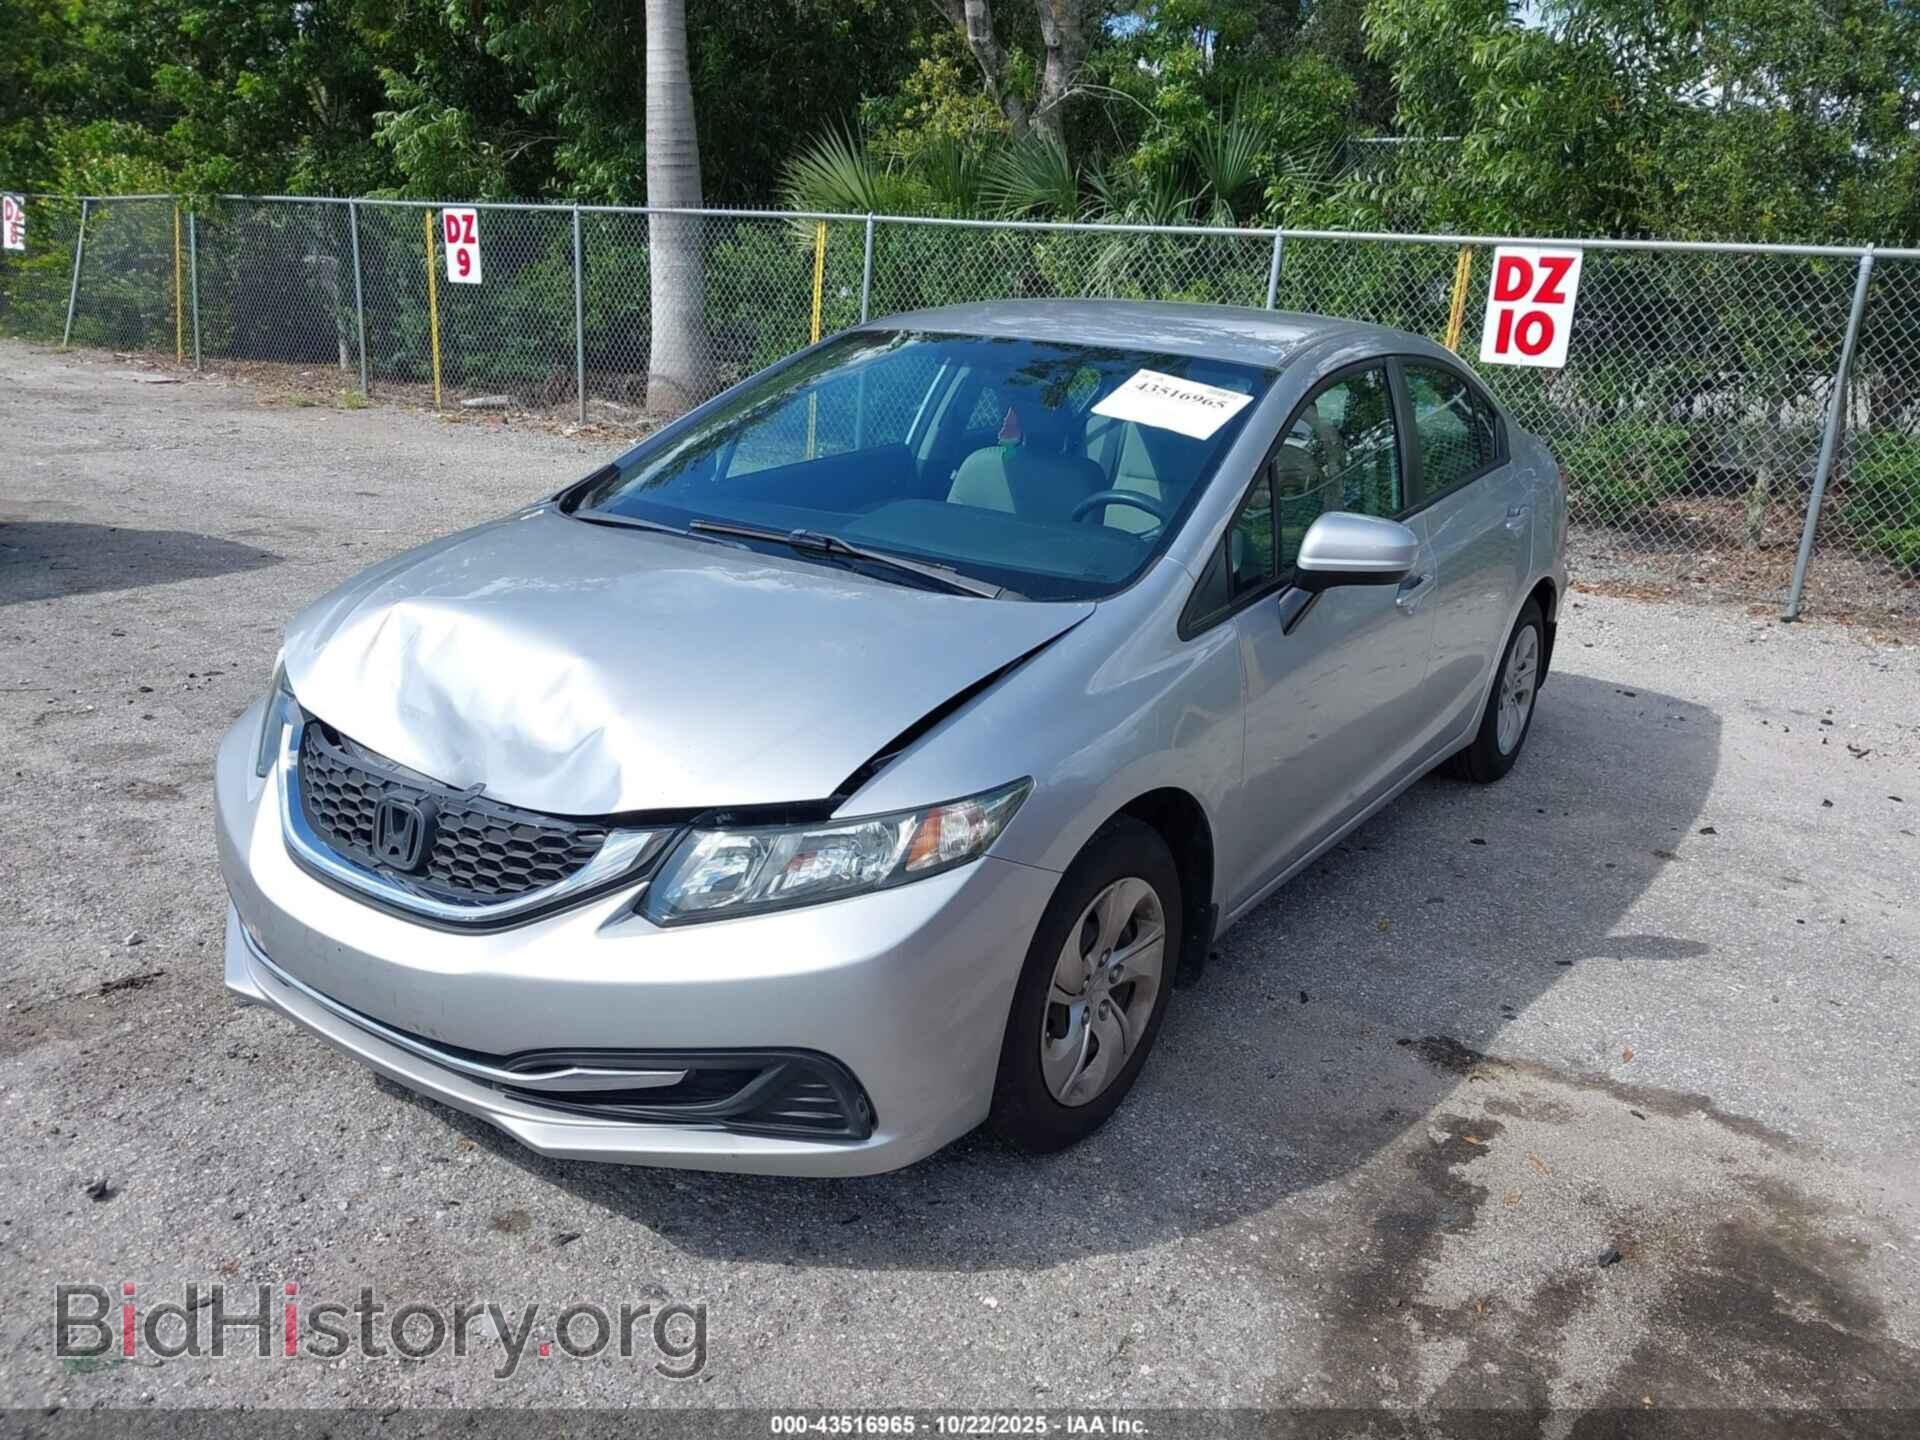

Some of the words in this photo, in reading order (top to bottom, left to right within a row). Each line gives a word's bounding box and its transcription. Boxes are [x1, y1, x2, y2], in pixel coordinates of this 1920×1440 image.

[446, 214, 476, 244] DZ
[456, 248, 471, 277] 9
[1494, 256, 1576, 304] DZ
[1495, 309, 1555, 356] 10
[1135, 382, 1229, 409] 43516965
